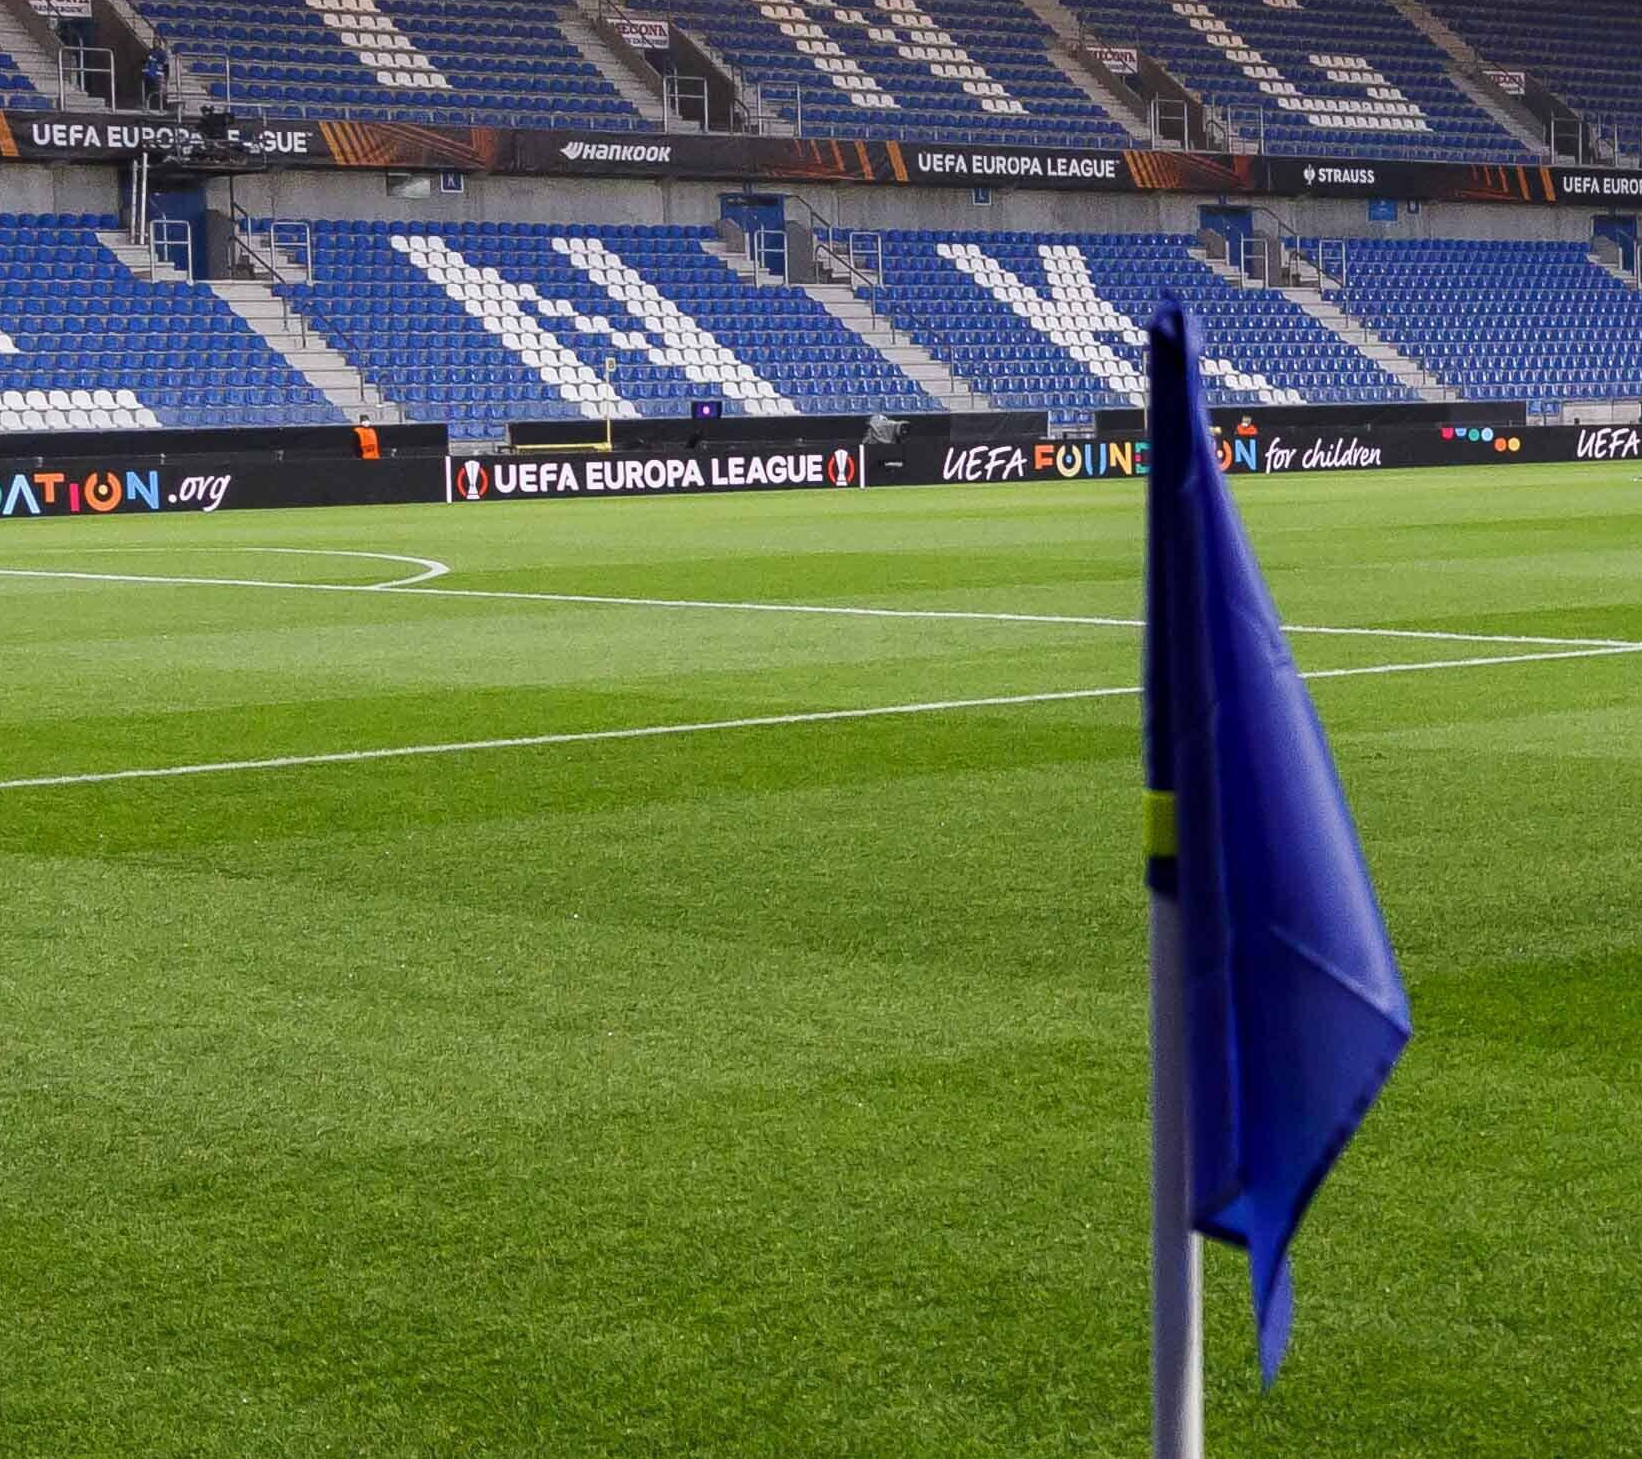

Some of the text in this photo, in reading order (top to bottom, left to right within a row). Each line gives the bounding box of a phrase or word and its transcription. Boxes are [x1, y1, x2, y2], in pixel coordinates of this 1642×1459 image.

[32, 124, 101, 147] UEFA
[918, 153, 1116, 178] UEFA EUROPA LEAGUE
[1318, 168, 1375, 183] STRAUSS
[1563, 176, 1600, 193] UEFA
[1577, 427, 1640, 458] UEFA
[942, 446, 1028, 480] UEFA
[1265, 437, 1297, 475] for
[1302, 437, 1382, 469] children
[494, 454, 822, 494] UEFA EUROPA LEAGUE
[169, 474, 231, 512] .org
